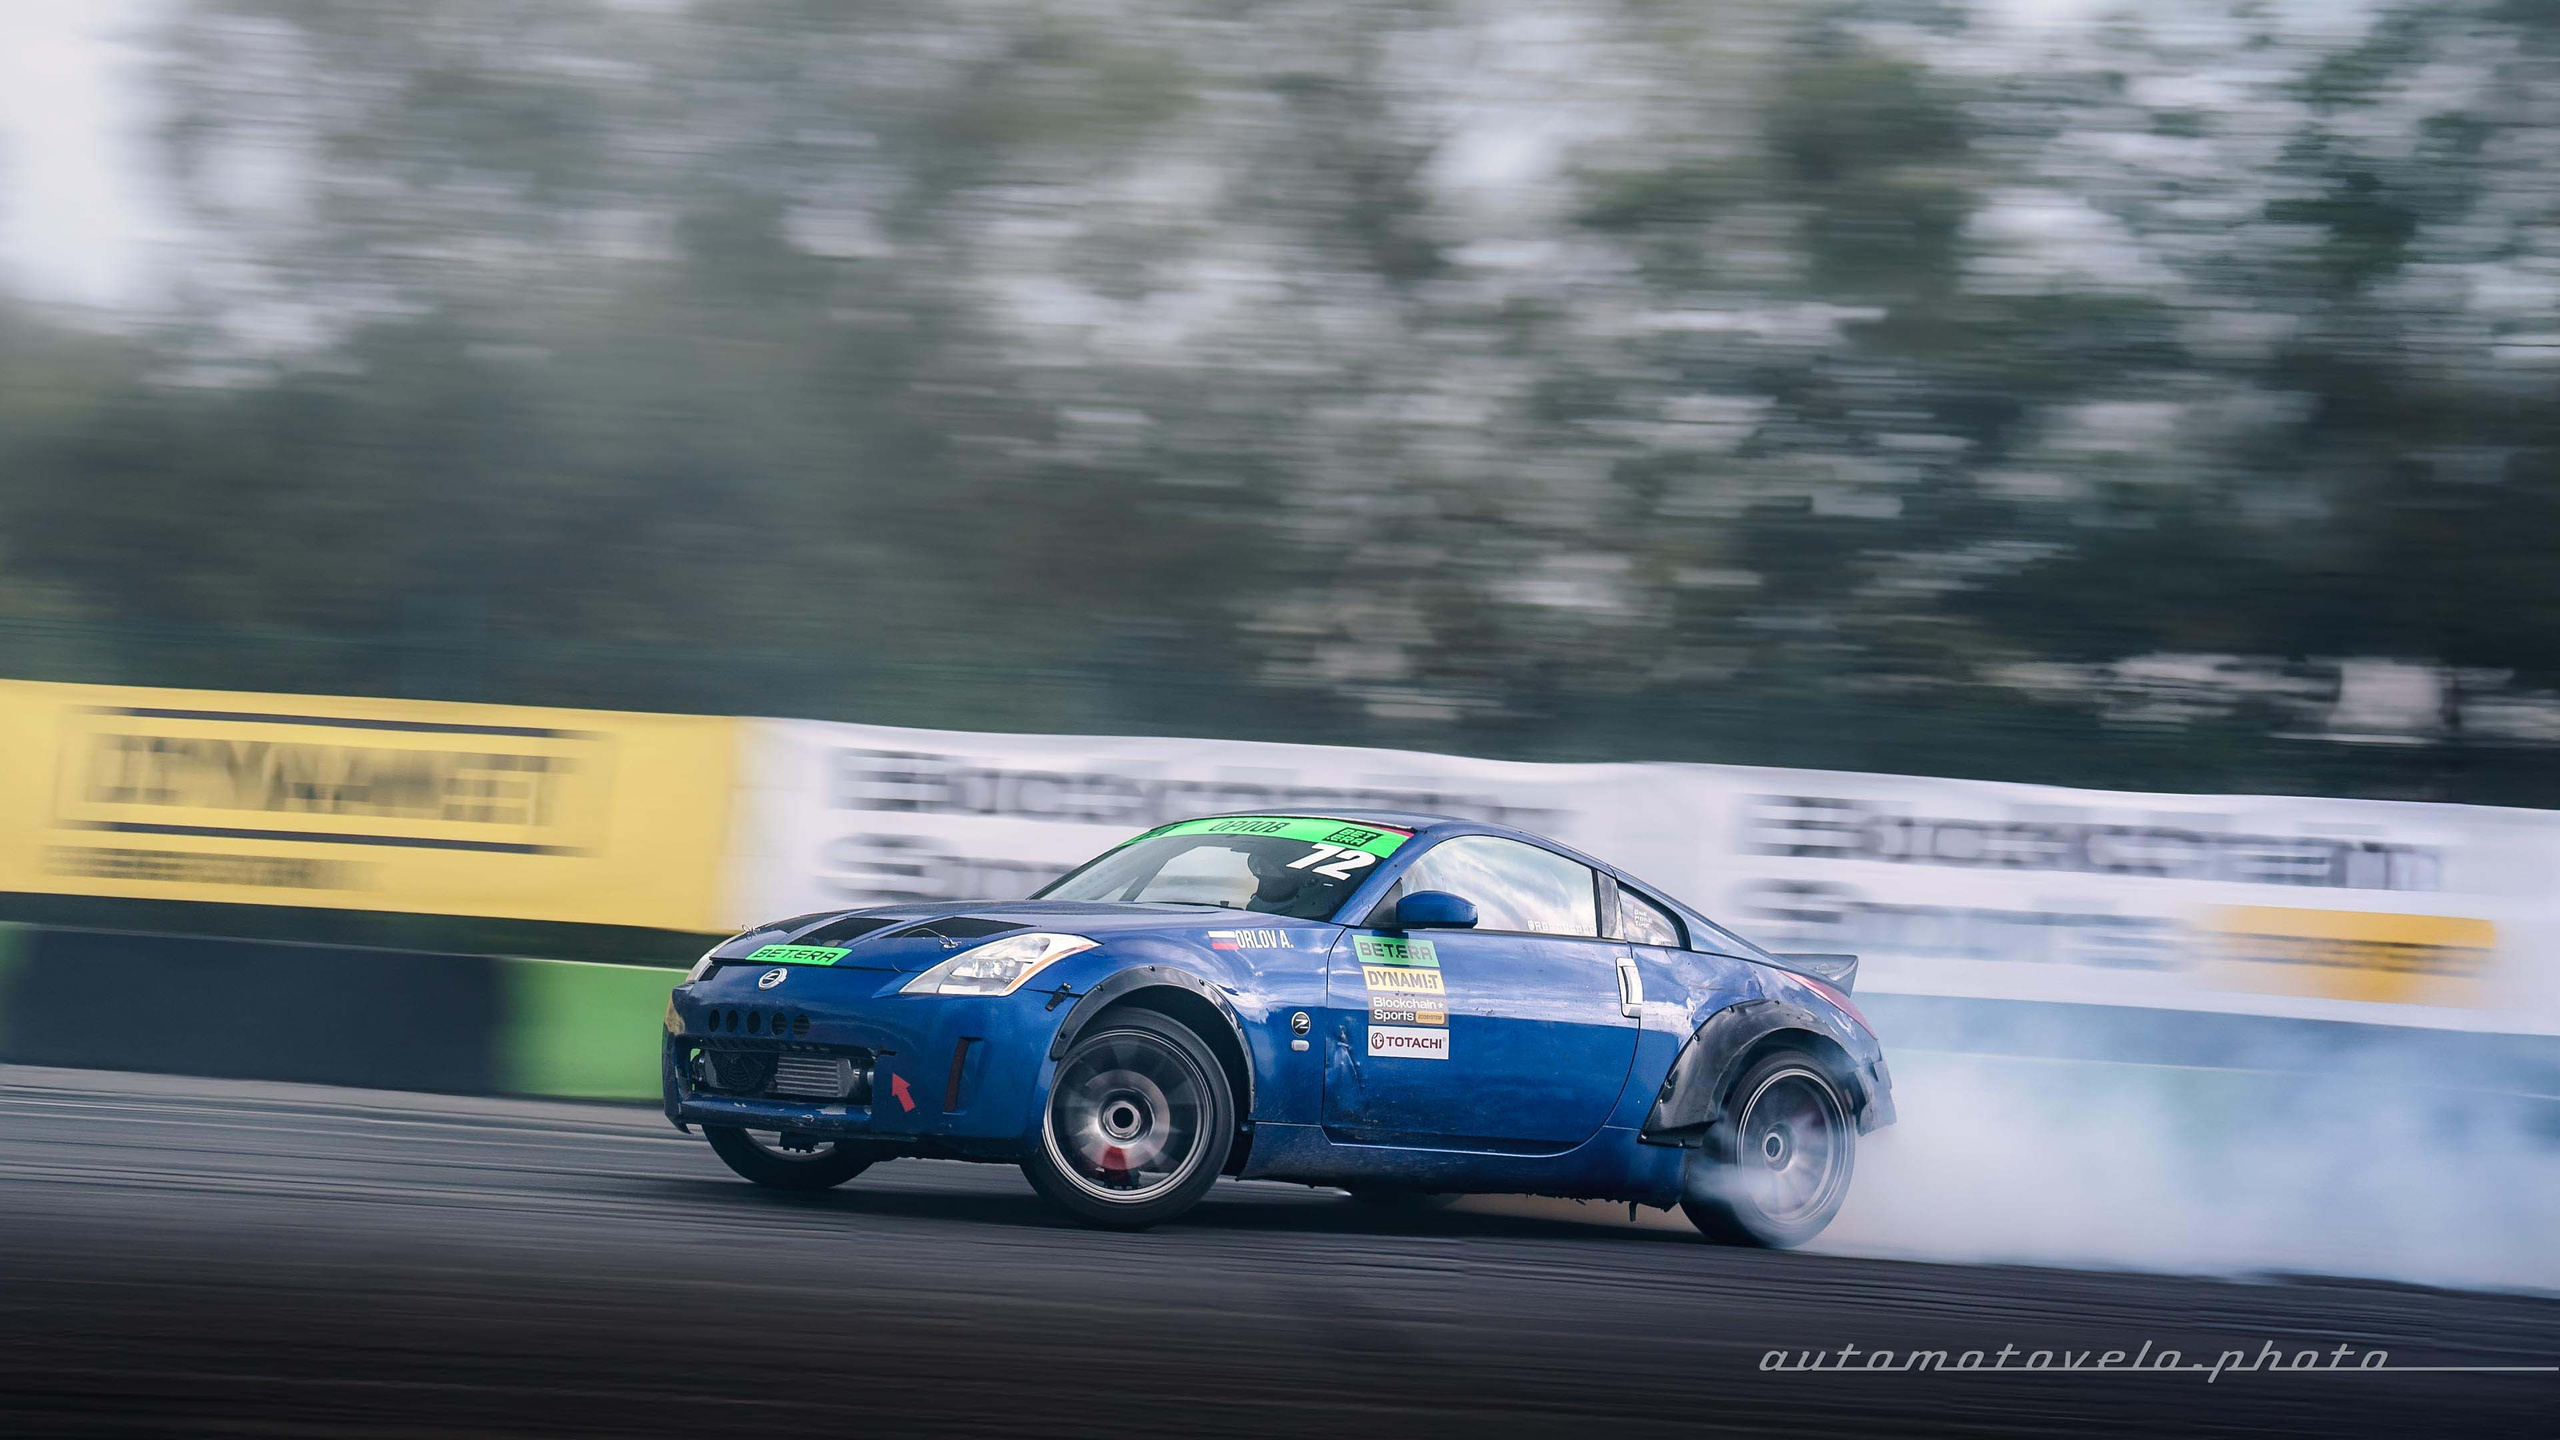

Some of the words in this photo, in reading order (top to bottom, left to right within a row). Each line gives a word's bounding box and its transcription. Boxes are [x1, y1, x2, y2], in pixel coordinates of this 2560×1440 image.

[1338, 828, 1378, 839] BET
[1286, 842, 1376, 880] 72
[1235, 929, 1277, 949] ORLOV
[1279, 929, 1295, 949] A.
[1373, 997, 1437, 1010] Blockchain
[1374, 1009, 1414, 1022] Sports
